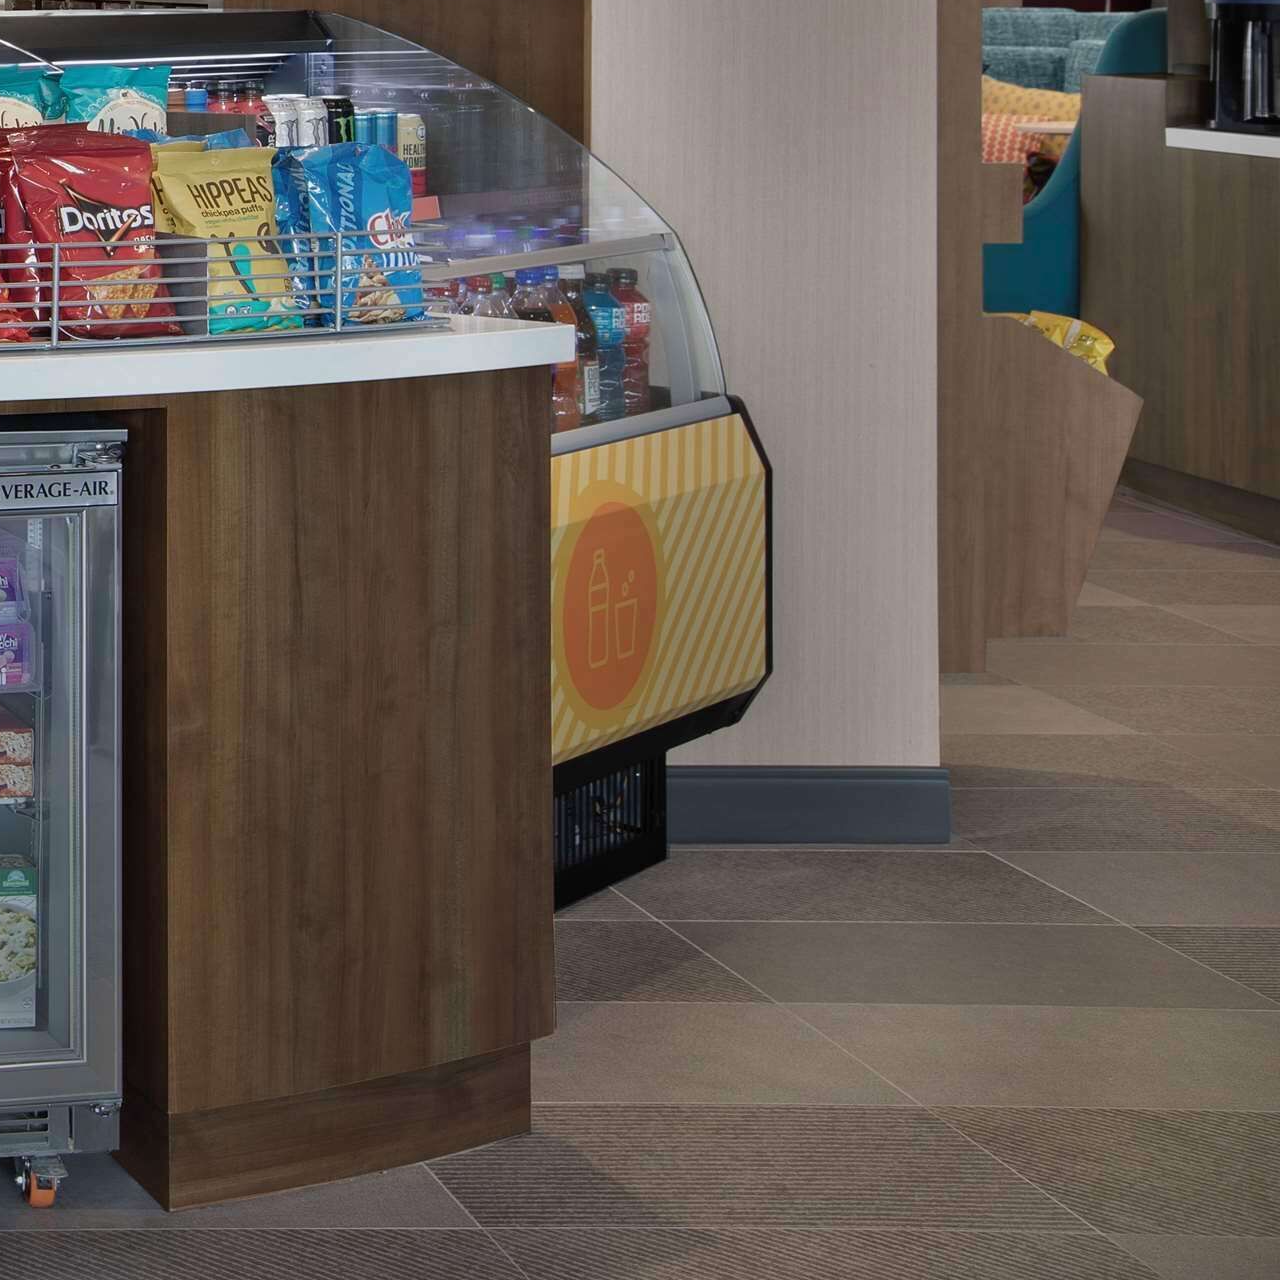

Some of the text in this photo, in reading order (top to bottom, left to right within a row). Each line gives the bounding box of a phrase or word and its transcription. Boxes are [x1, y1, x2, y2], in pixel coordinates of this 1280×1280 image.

[186, 175, 273, 209] HIPPEAS
[60, 204, 154, 233] Doritos
[201, 204, 264, 218] chickpea puffs
